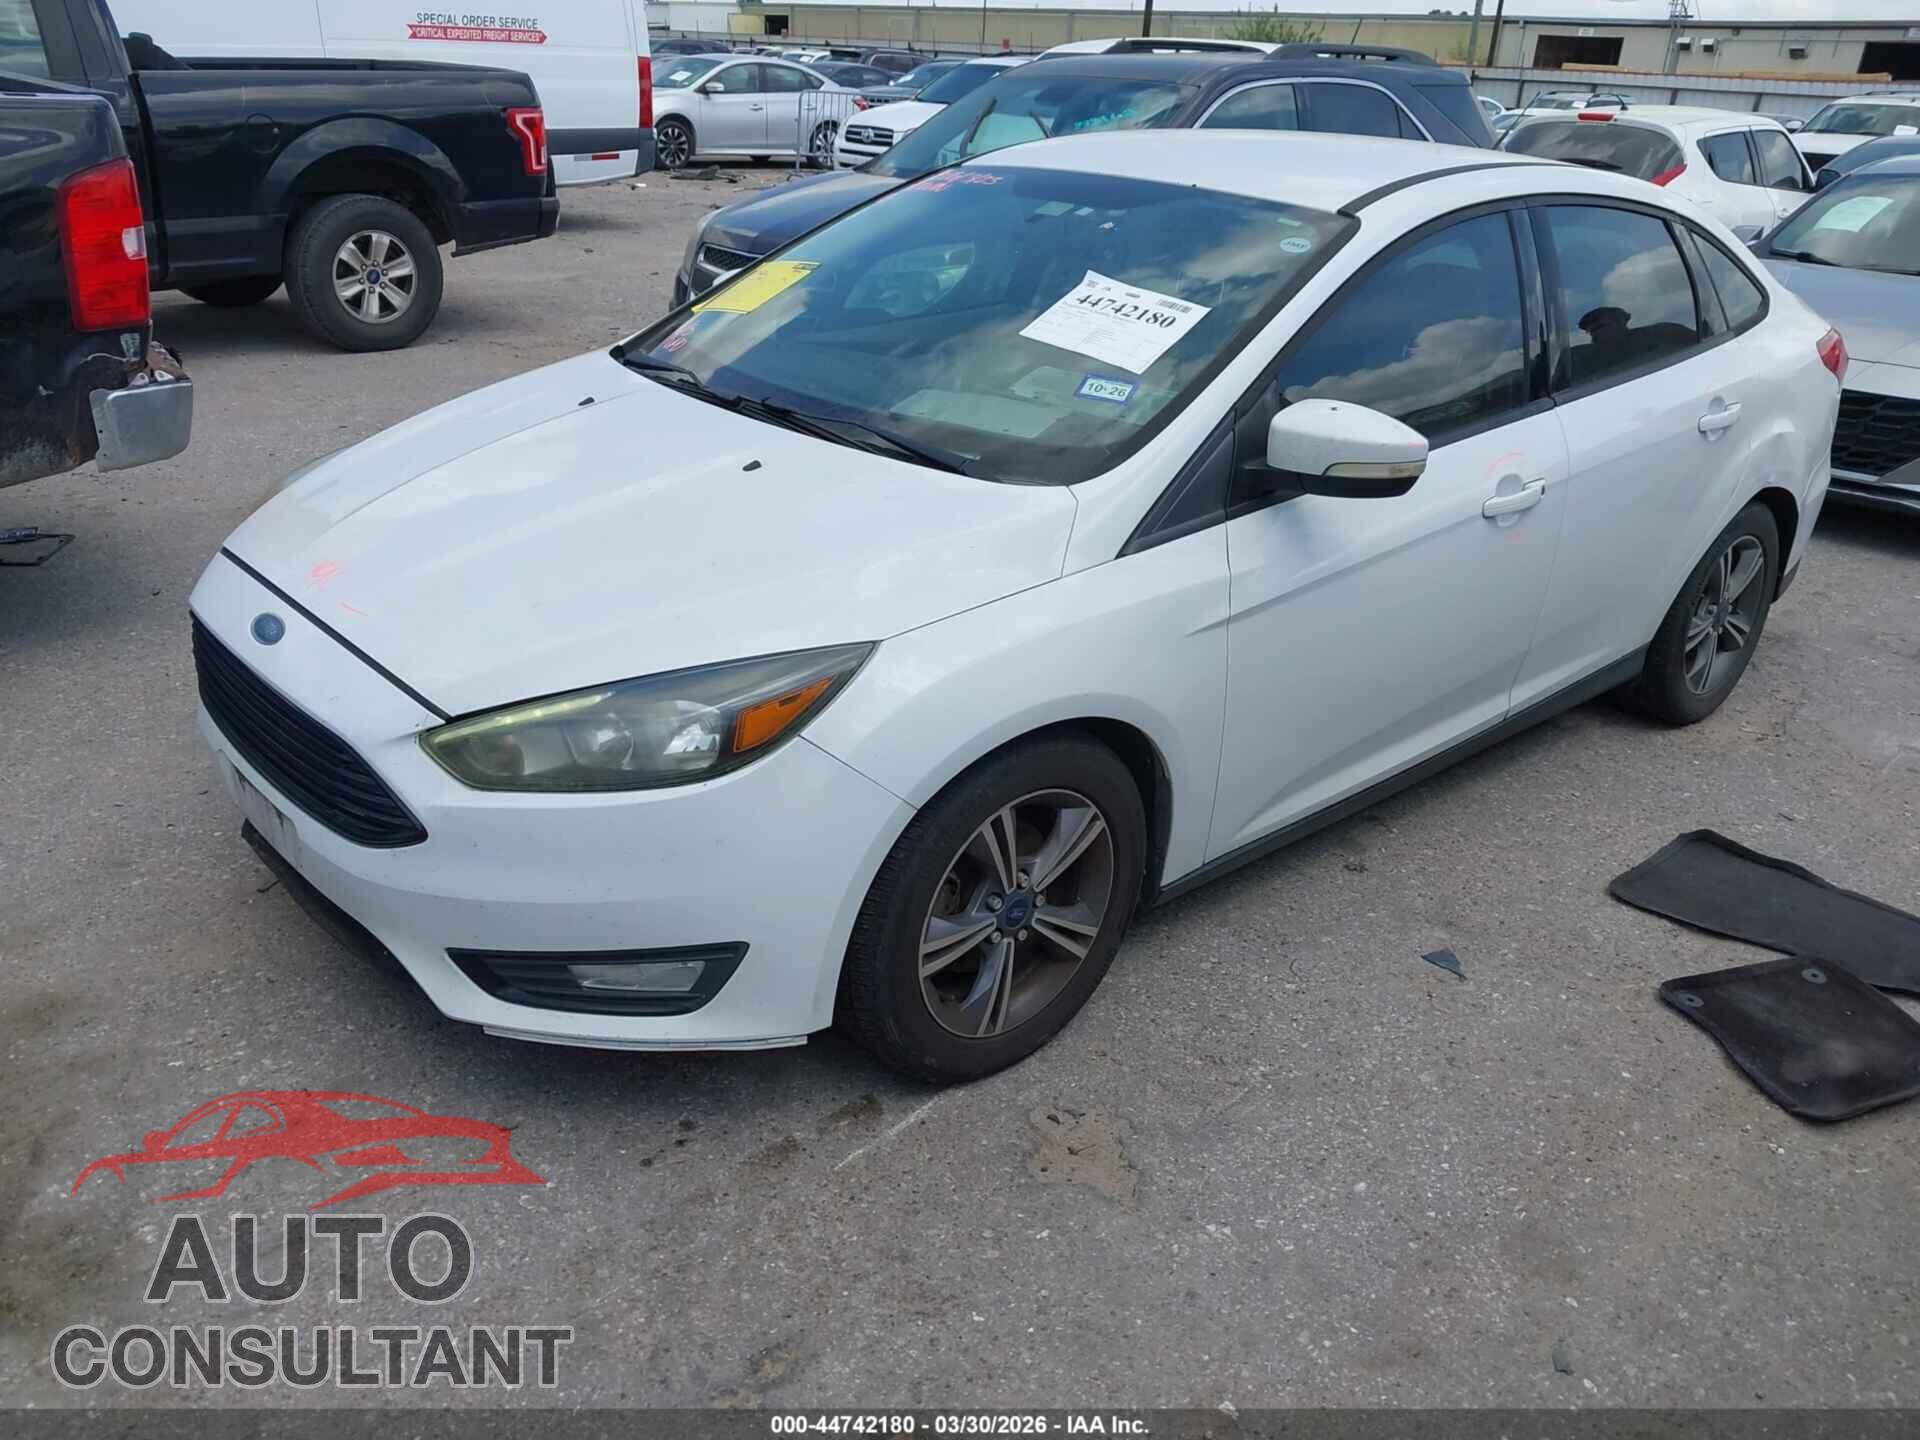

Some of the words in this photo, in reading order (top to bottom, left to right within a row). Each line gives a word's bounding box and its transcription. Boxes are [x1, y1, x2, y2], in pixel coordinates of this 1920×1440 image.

[416, 12, 459, 25] SPECIAL
[462, 14, 496, 27] ORDER
[499, 17, 538, 29] SERVICE
[447, 27, 482, 39] EXPEDITED
[483, 29, 509, 40] FREIGHT
[1076, 294, 1176, 329] 44742180
